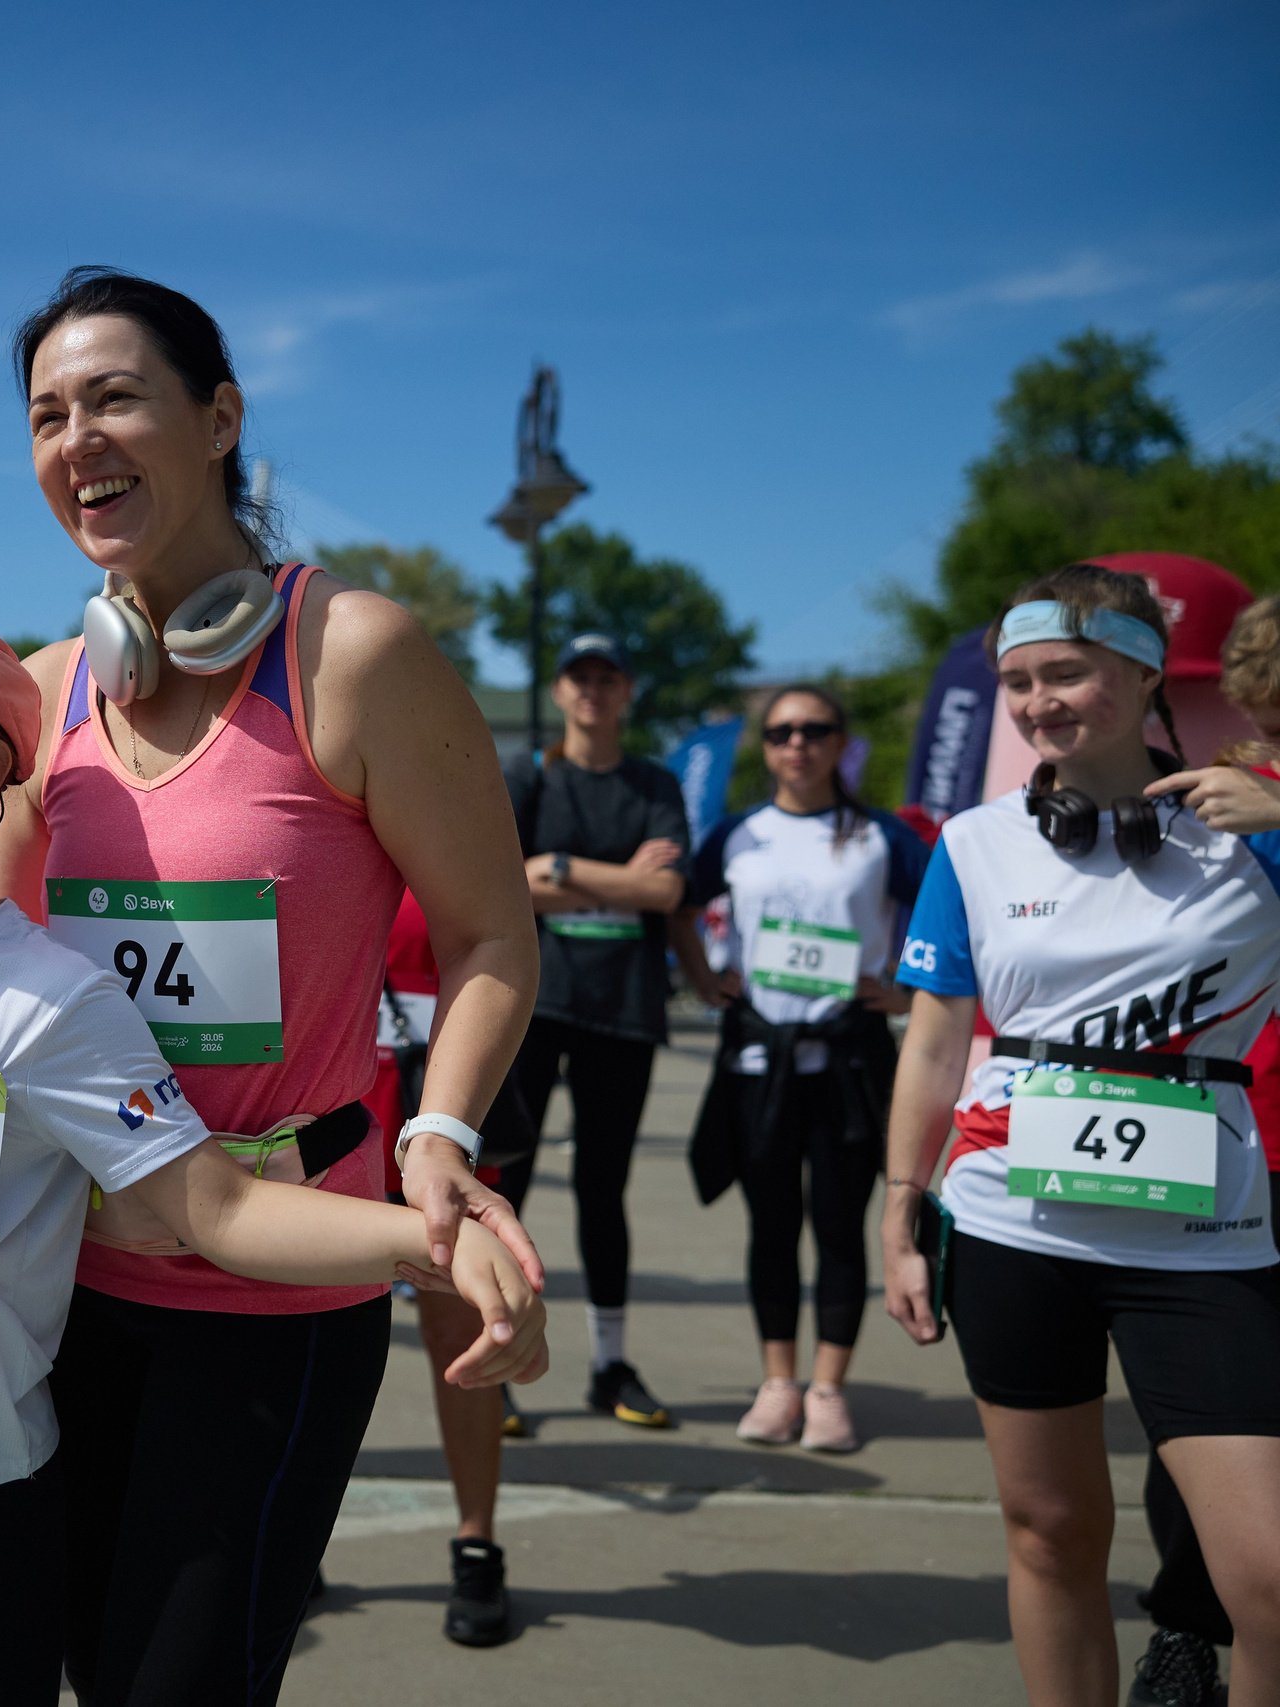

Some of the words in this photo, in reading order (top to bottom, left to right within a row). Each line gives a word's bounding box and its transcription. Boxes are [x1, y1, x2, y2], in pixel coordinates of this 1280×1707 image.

[92, 892, 105, 904] 4,2
[140, 897, 175, 911] Звук
[786, 942, 824, 970] 20
[900, 936, 937, 973] СБ
[113, 940, 195, 1006] 94
[200, 1033, 224, 1042] 30.05
[201, 1043, 222, 1052] 2026
[1104, 1083, 1137, 1098] Звук
[1073, 1115, 1146, 1163] 49
